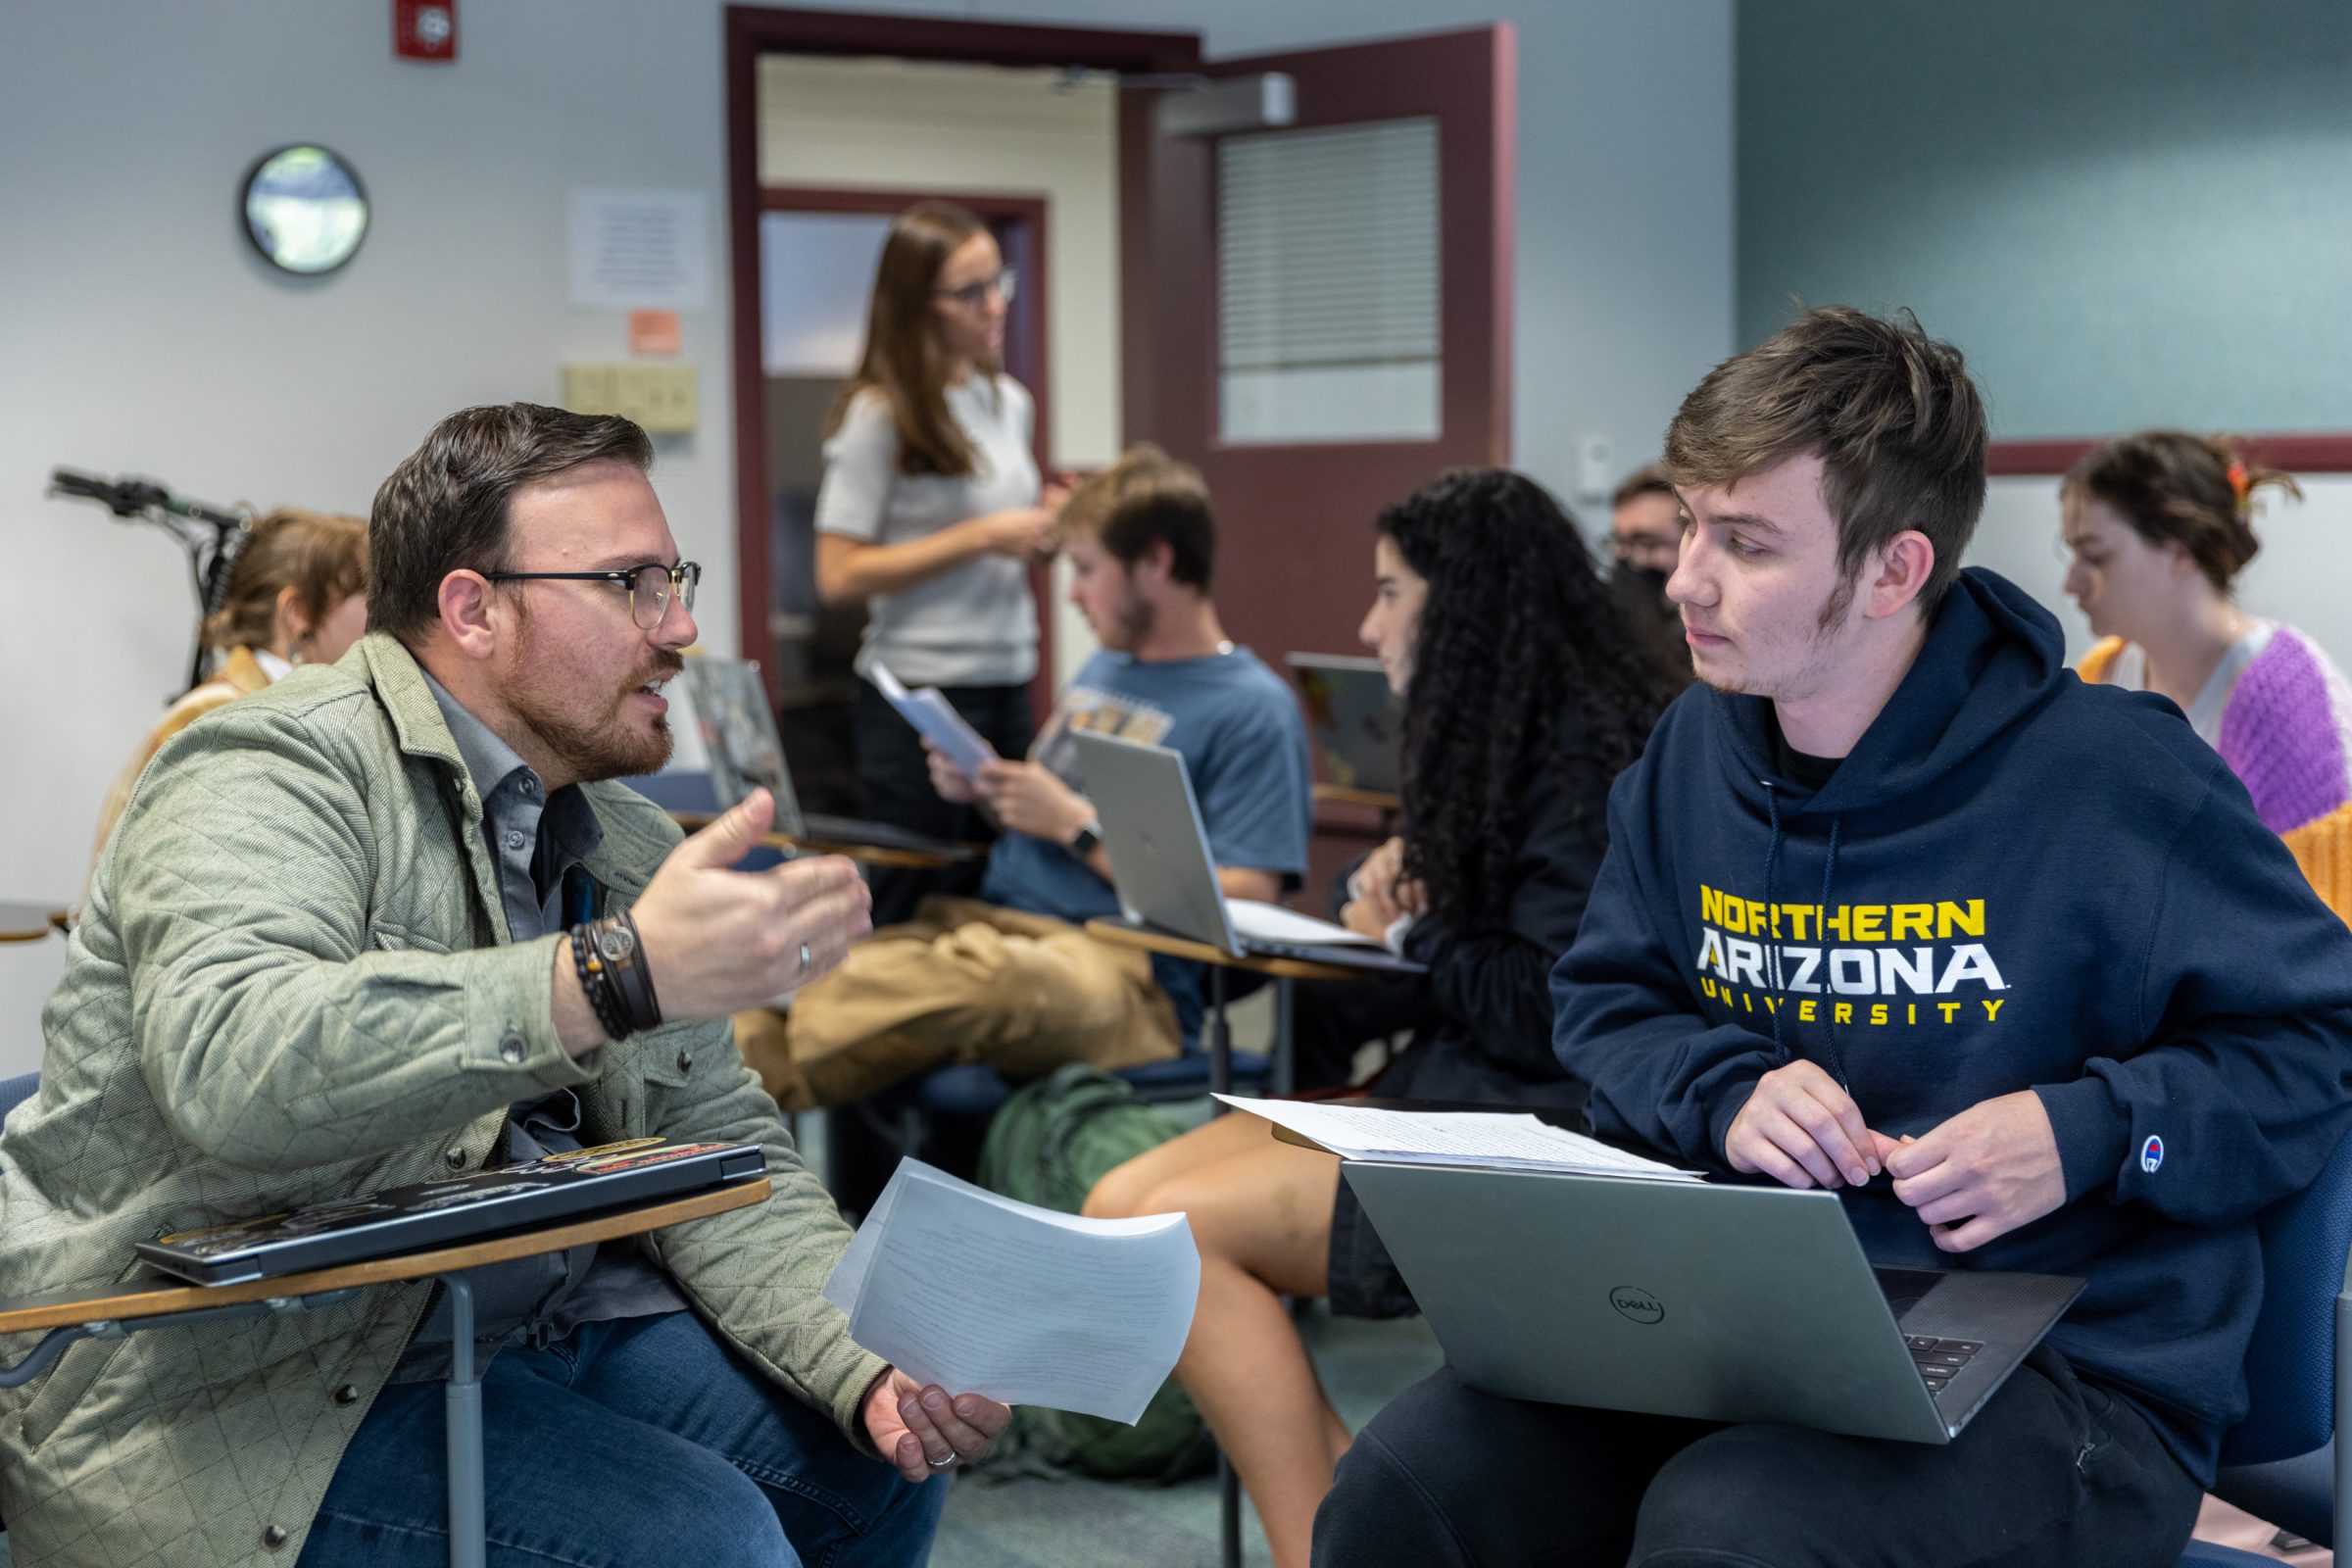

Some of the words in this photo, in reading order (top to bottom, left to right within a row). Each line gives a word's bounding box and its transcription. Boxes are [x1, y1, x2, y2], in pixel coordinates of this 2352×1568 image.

[1700, 884, 1984, 941] NORTHERN
[1697, 926, 2006, 996] ARIZONA
[1700, 976, 2005, 1026] UNIVERSITY
[1617, 1299, 1658, 1311] DELL
